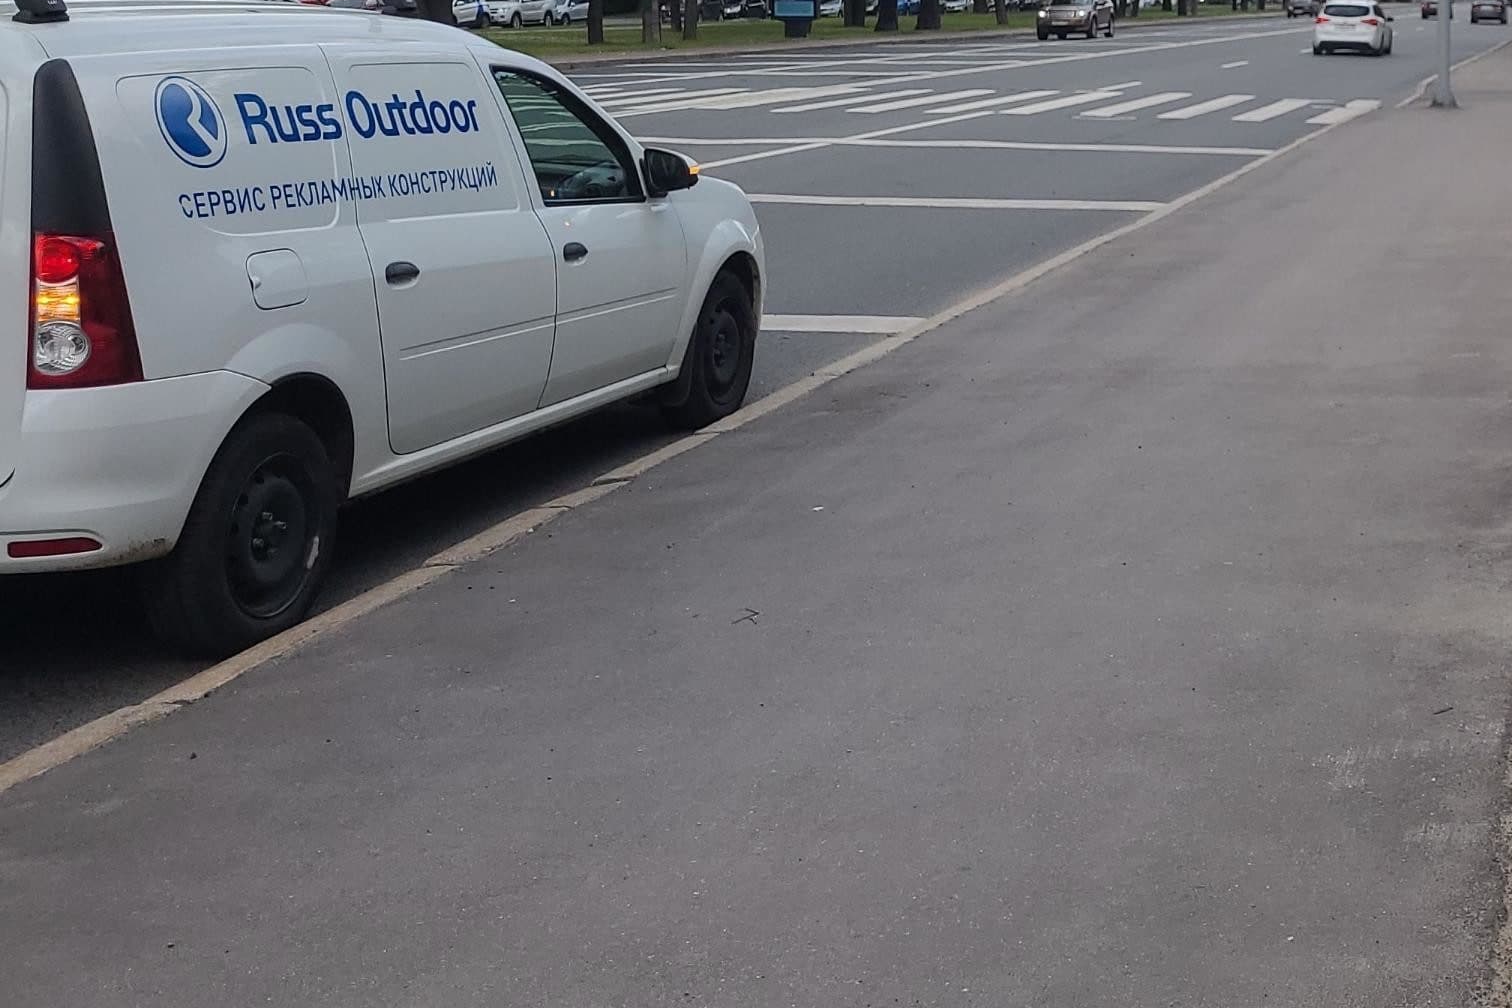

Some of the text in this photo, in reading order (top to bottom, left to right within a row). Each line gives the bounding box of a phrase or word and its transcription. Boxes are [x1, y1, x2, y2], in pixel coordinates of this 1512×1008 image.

[234, 90, 479, 145] Russ Outdoor
[178, 161, 498, 219] СЕРВИС РЕКЛАМНЫХ КОНСТРУКЦИЙ
